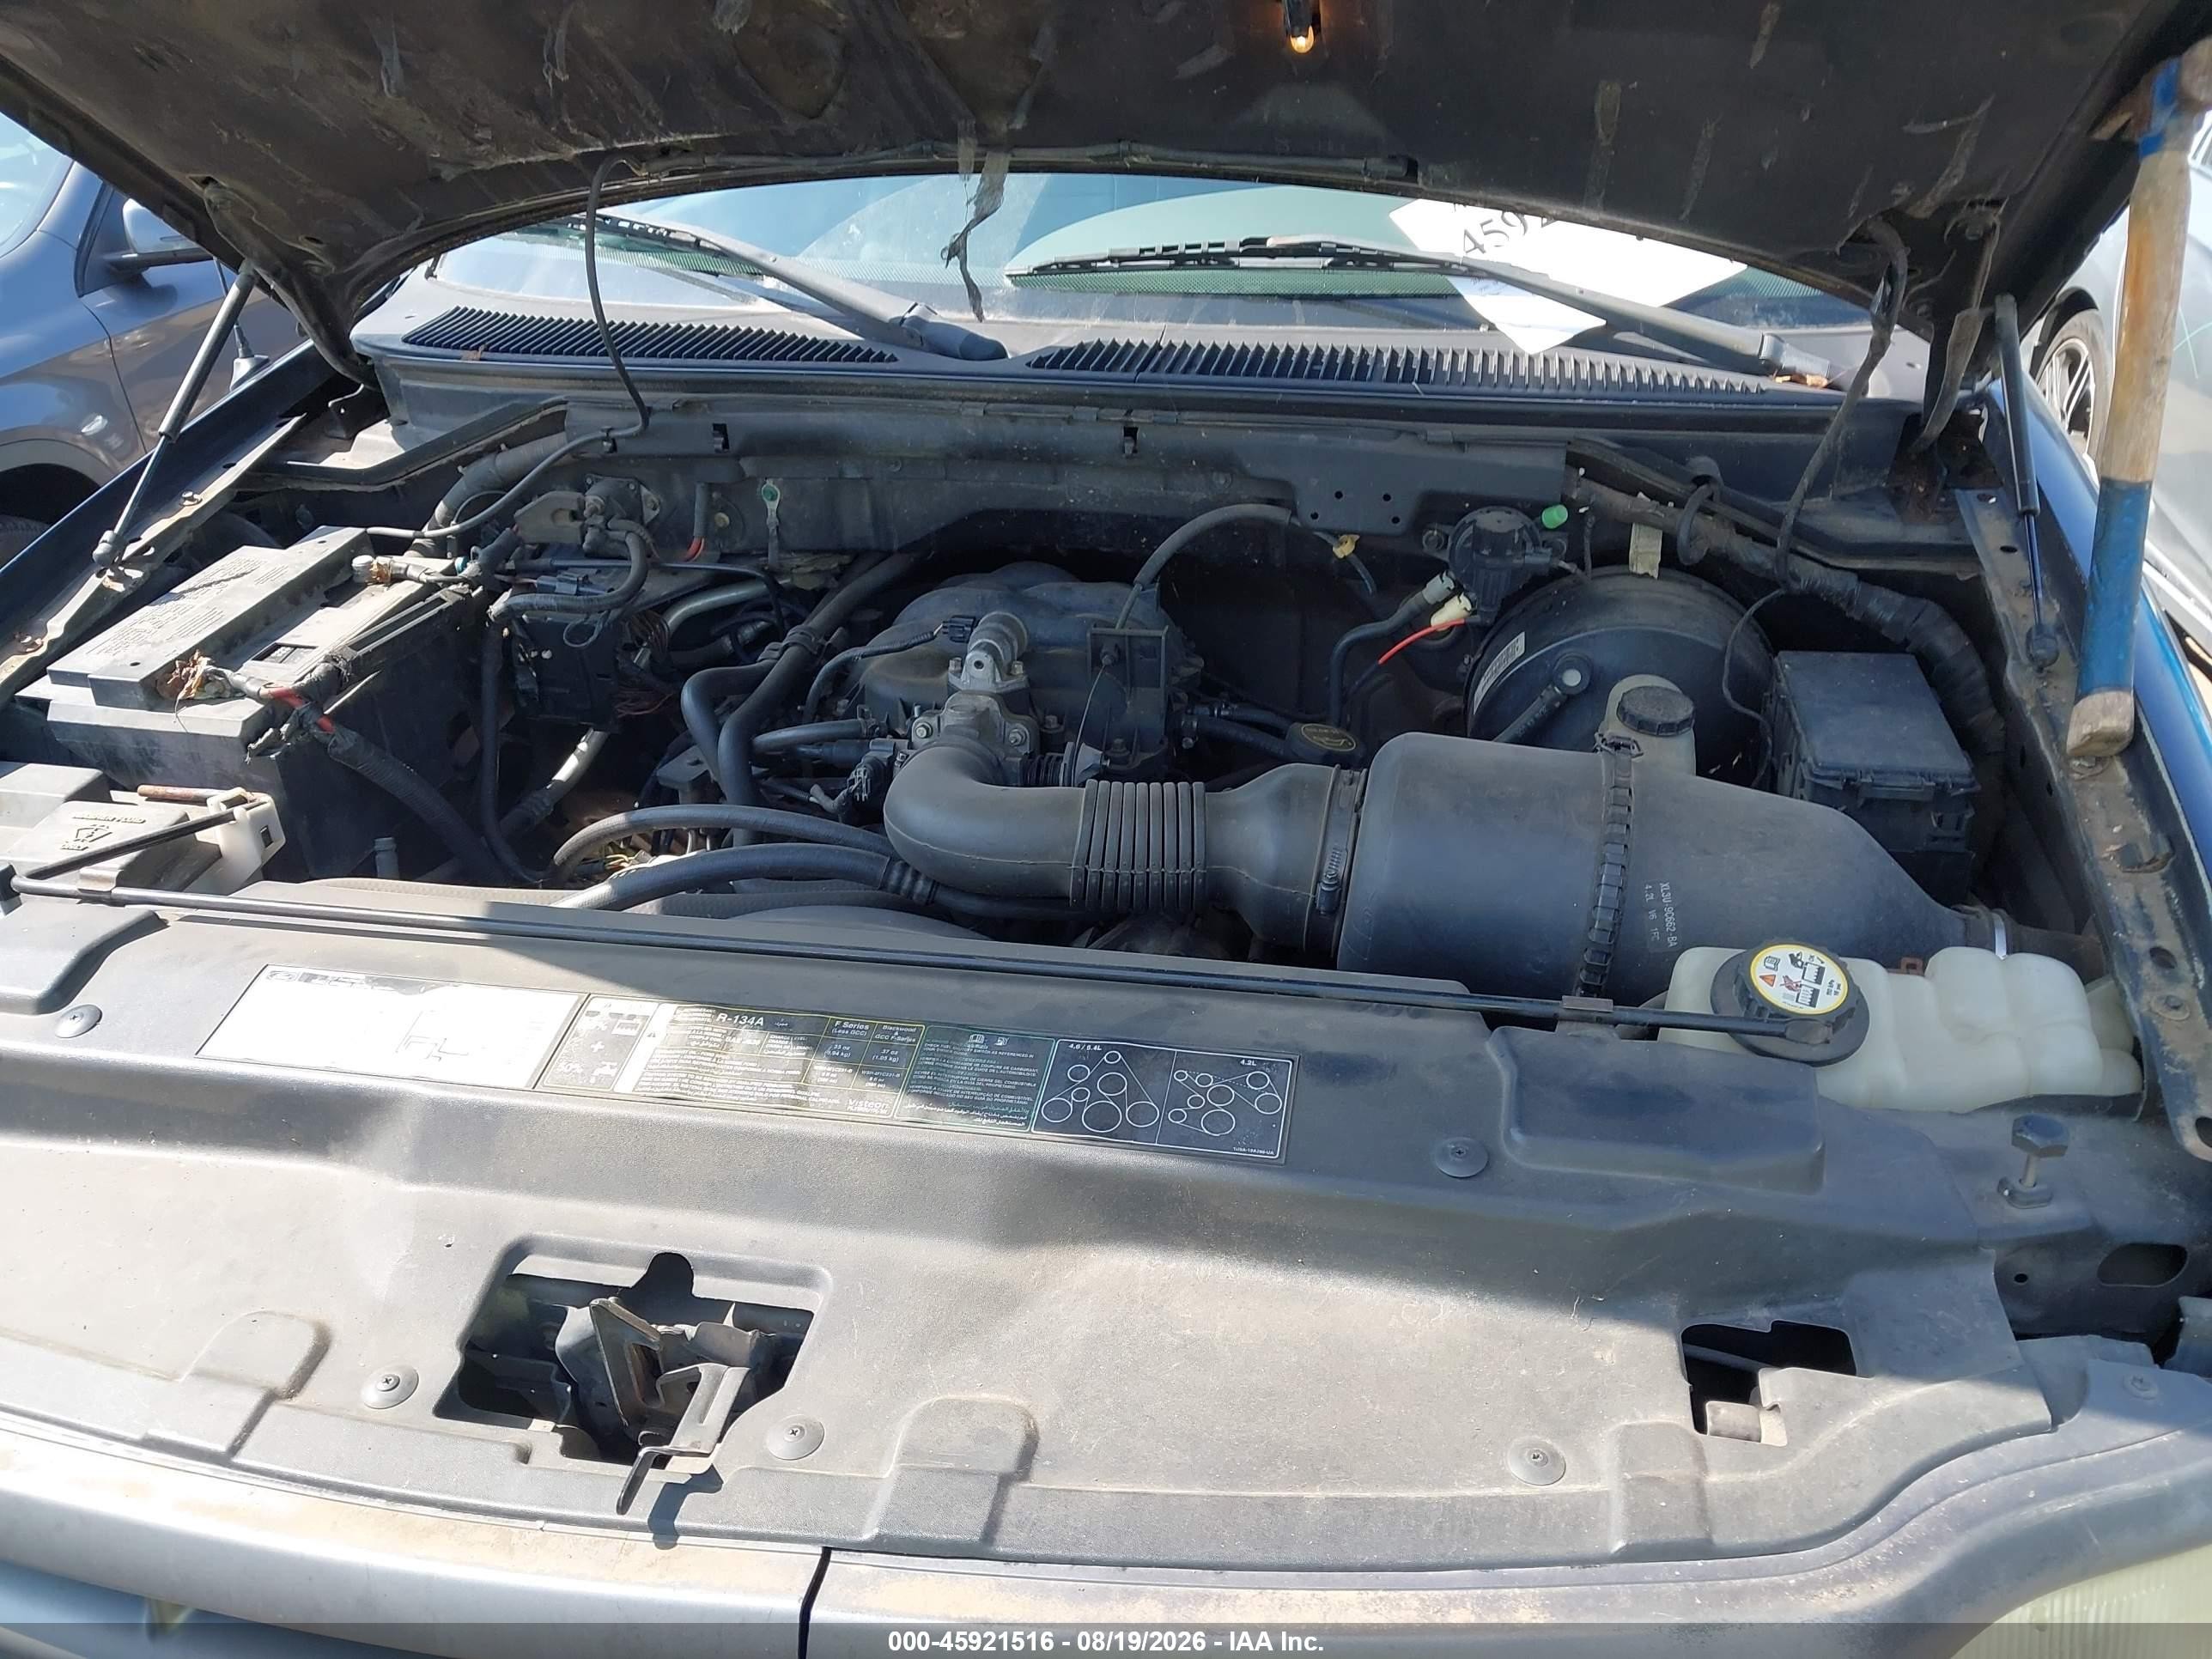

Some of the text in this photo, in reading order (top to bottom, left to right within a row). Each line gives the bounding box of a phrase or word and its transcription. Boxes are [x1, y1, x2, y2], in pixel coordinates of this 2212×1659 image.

[1463, 209, 1559, 254] 459
[1645, 884, 1654, 902] 4.2L
[1649, 909, 1656, 920] V6
[716, 1013, 764, 1025] R-134A
